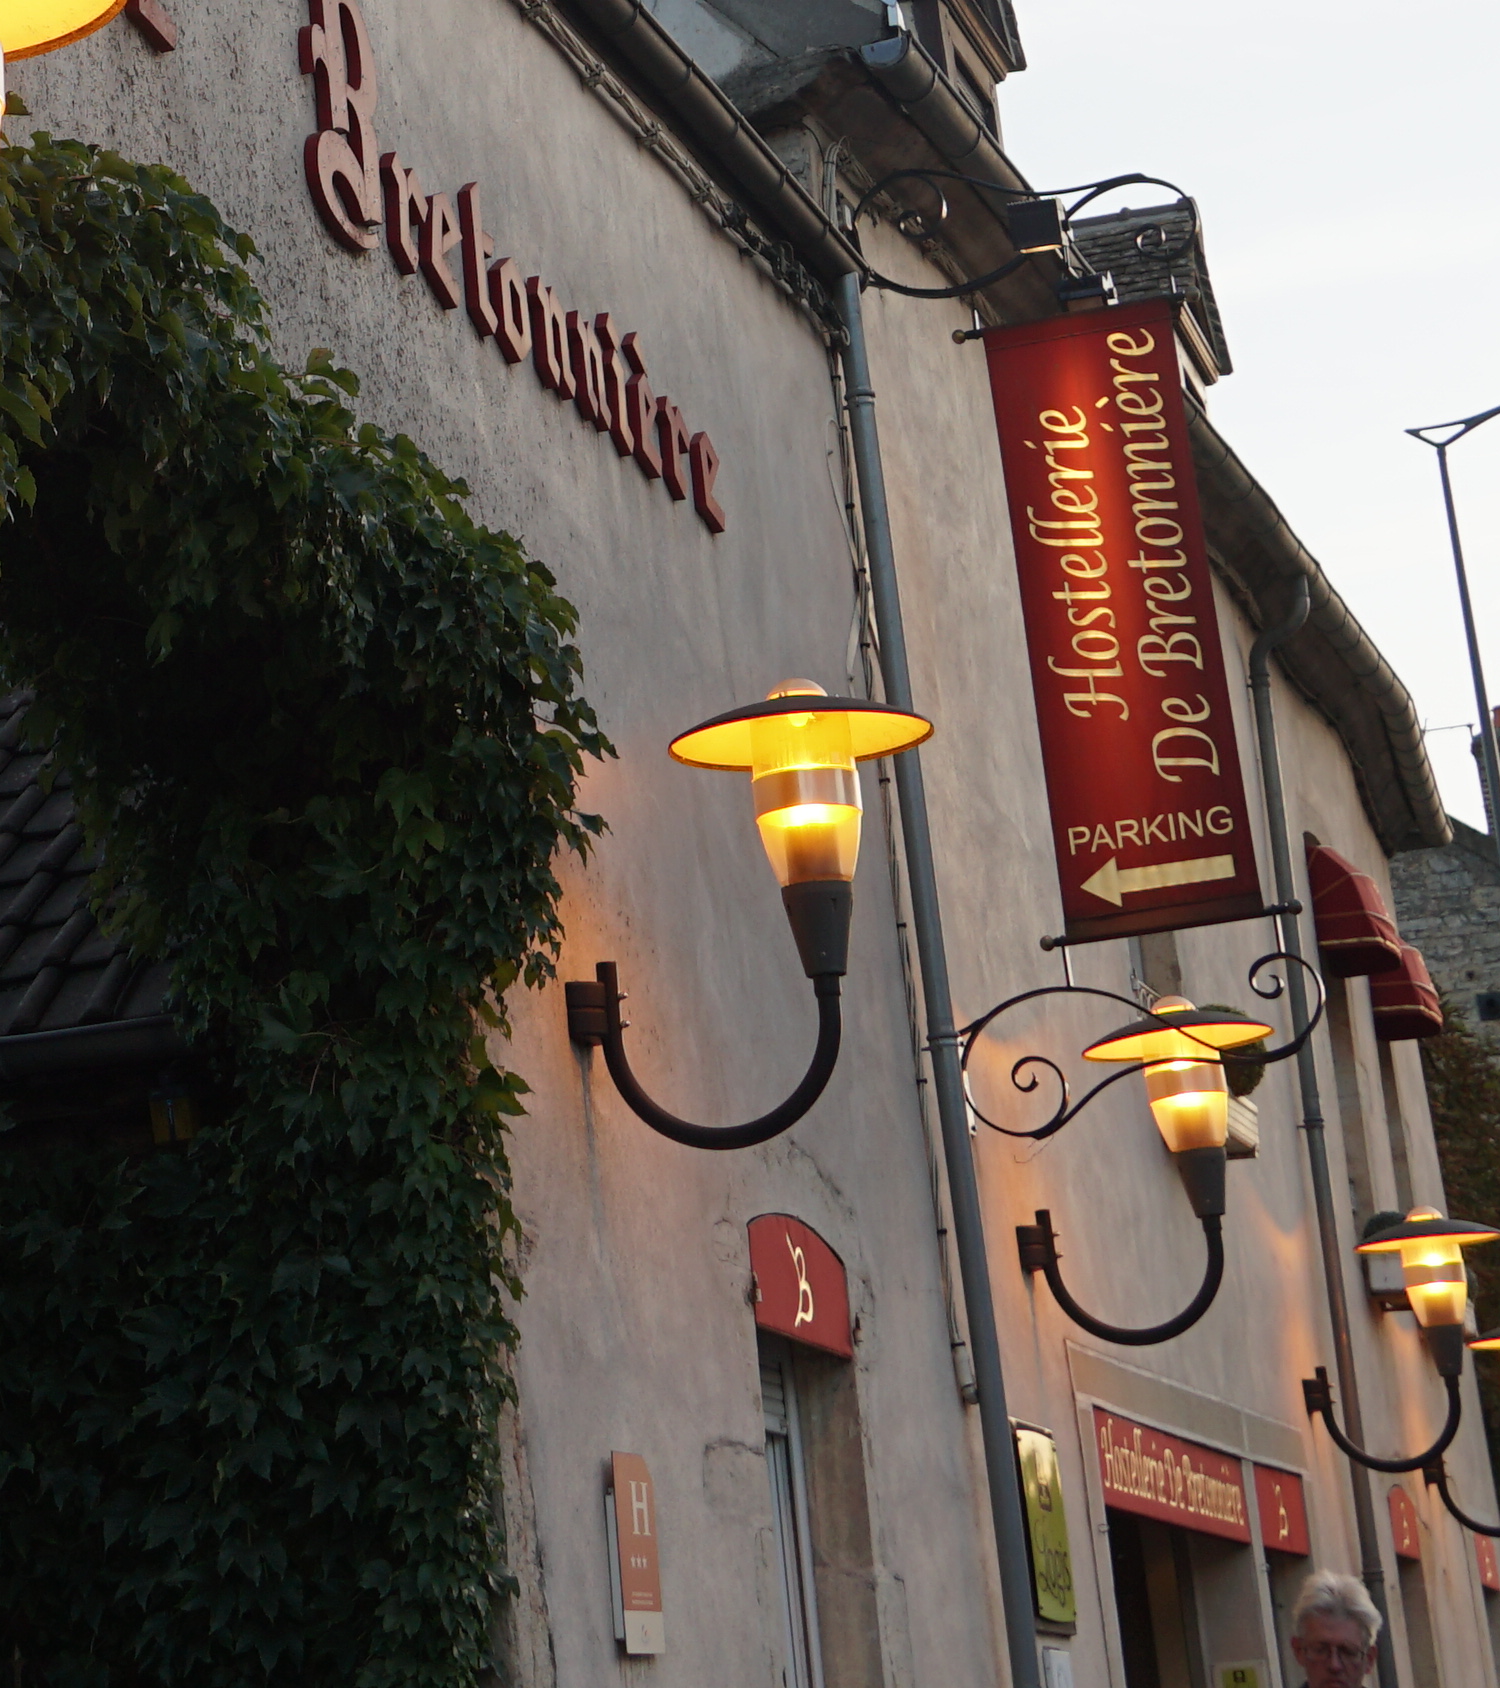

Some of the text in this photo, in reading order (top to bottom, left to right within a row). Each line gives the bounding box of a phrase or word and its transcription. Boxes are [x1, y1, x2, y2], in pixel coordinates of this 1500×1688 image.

[1021, 403, 1130, 722] Hostellerie
[1095, 326, 1222, 784] De Bretonnière
[1066, 804, 1235, 857] PARKING
[628, 1479, 652, 1537] H
